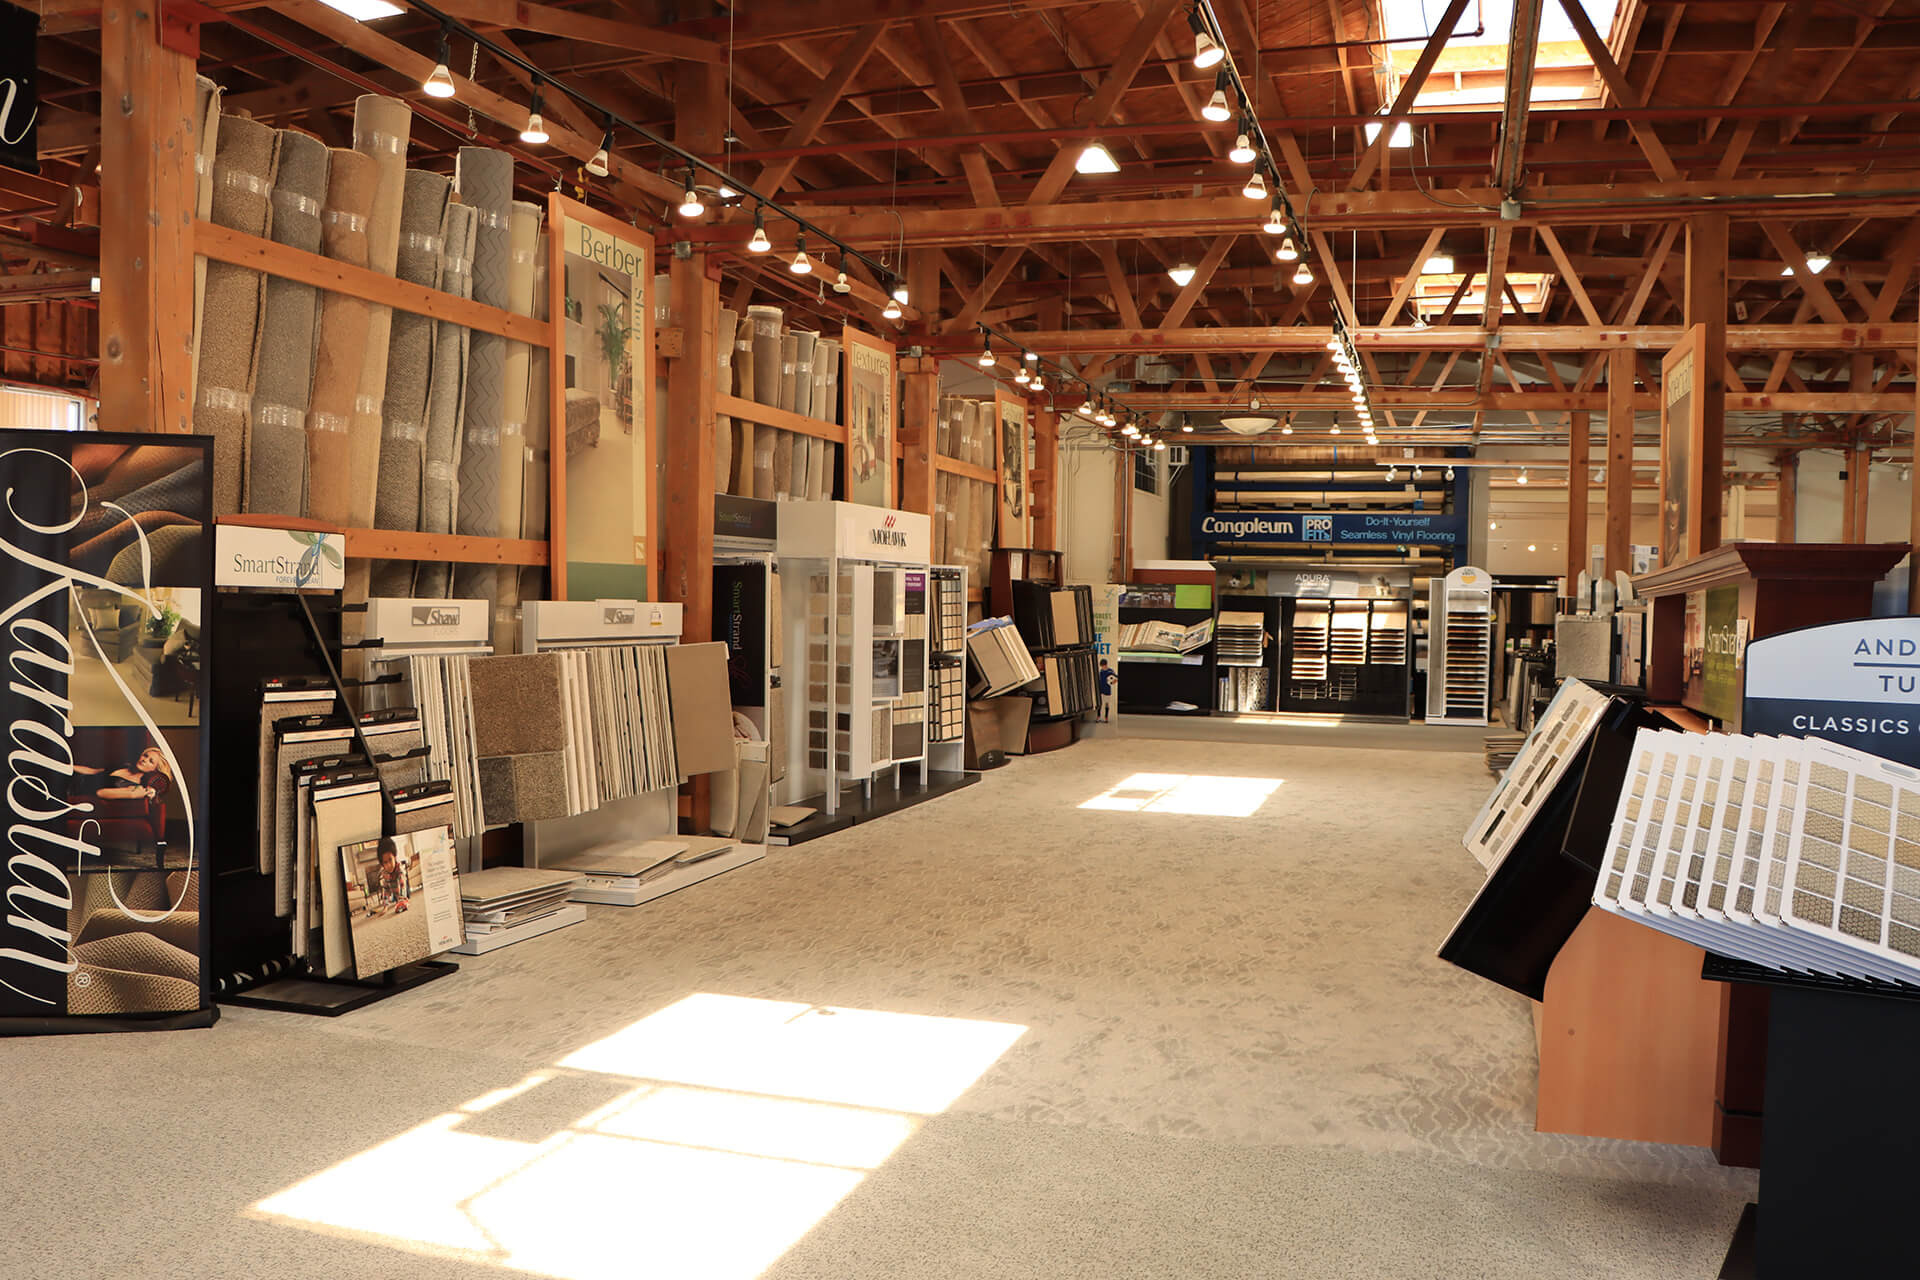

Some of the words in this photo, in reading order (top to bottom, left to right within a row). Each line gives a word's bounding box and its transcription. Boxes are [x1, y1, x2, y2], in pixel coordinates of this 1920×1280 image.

[581, 224, 642, 278] Berber
[852, 343, 890, 376] Textures
[1201, 516, 1294, 537] Congoleum
[1306, 519, 1332, 530] PRO
[872, 528, 907, 547] MOHAWK
[1340, 529, 1388, 540] Seamless
[1392, 530, 1414, 541] Vinyl
[1416, 531, 1456, 543] Flooring
[233, 553, 320, 575] SmartStrand
[1295, 573, 1330, 583] ADURA
[431, 609, 460, 625] Shaw
[733, 581, 743, 650] SmartStrand
[1854, 638, 1917, 656] AND
[1878, 675, 1916, 693] TU
[0, 448, 195, 1005] Karastan
[1792, 715, 1910, 735] CLASSICS
